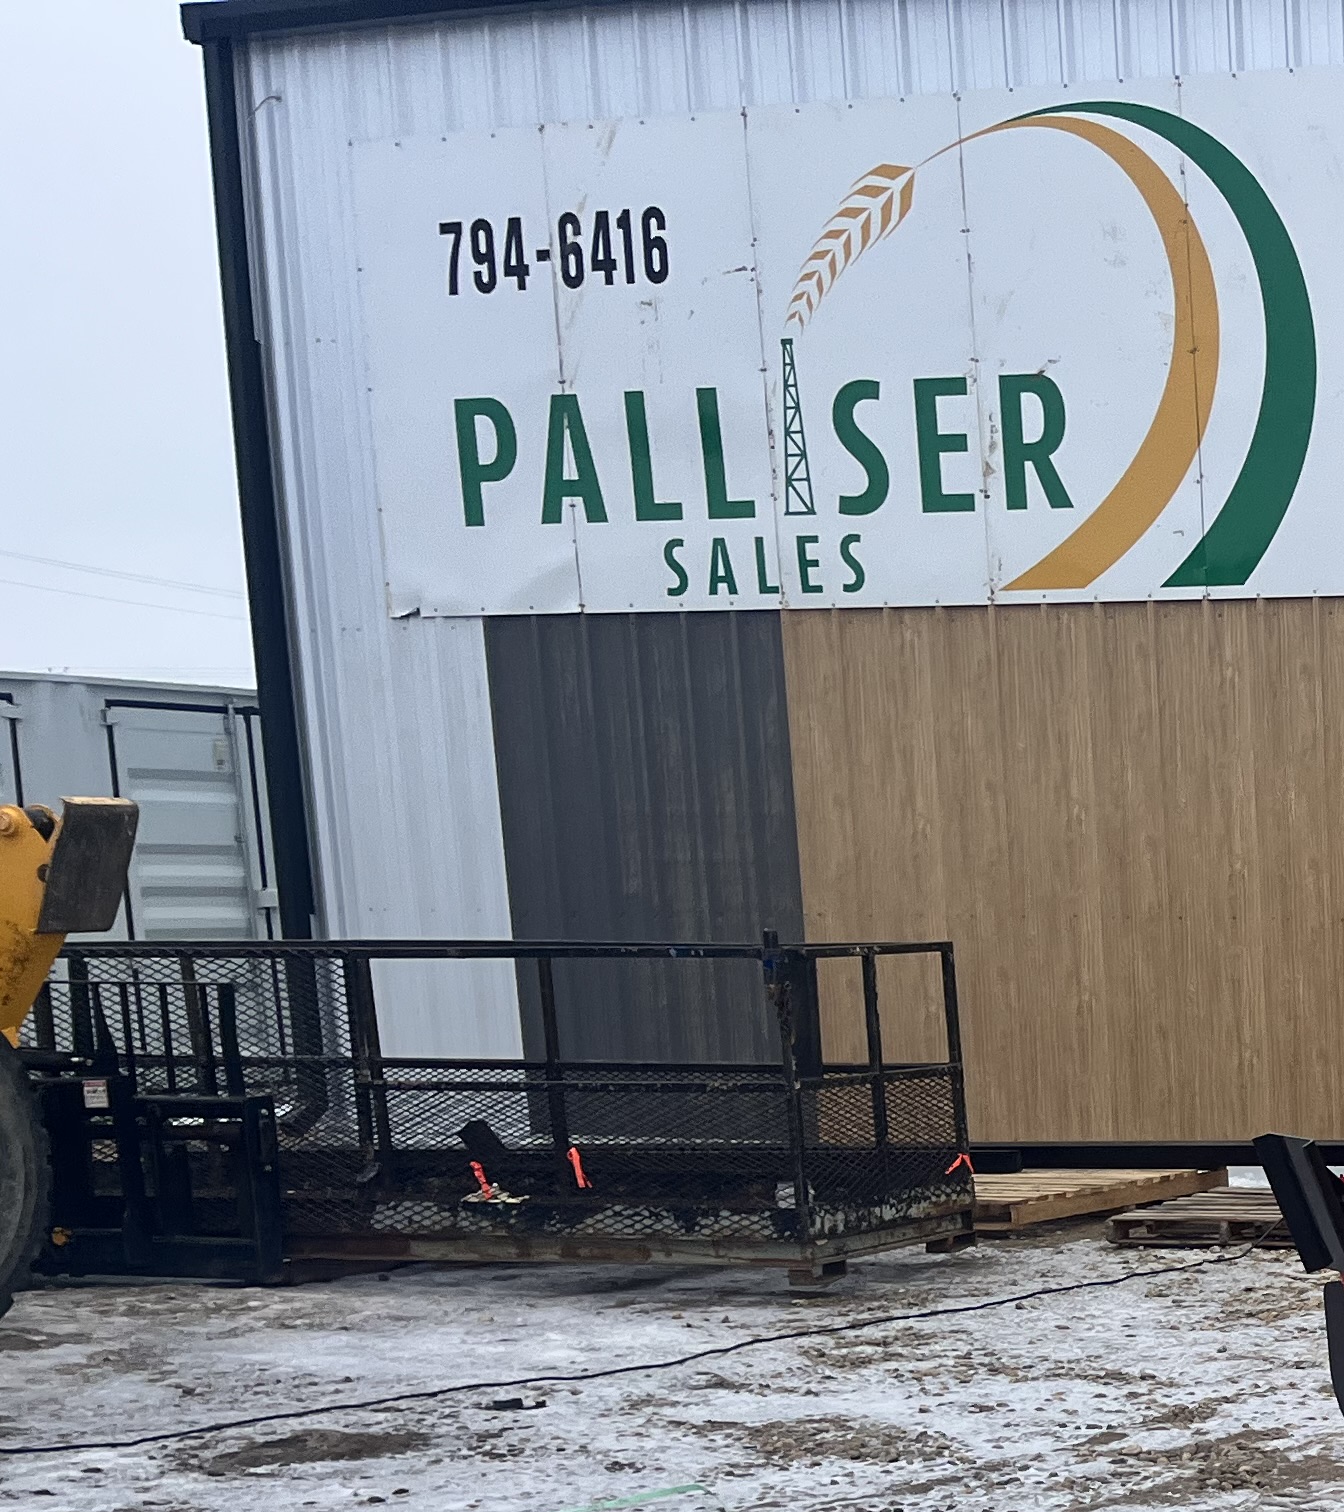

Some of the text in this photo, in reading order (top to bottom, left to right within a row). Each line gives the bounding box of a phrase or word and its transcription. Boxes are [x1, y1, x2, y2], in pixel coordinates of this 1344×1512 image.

[438, 206, 670, 296] 794-6416
[452, 338, 1075, 527] PALLISER
[663, 532, 868, 598] SALES
